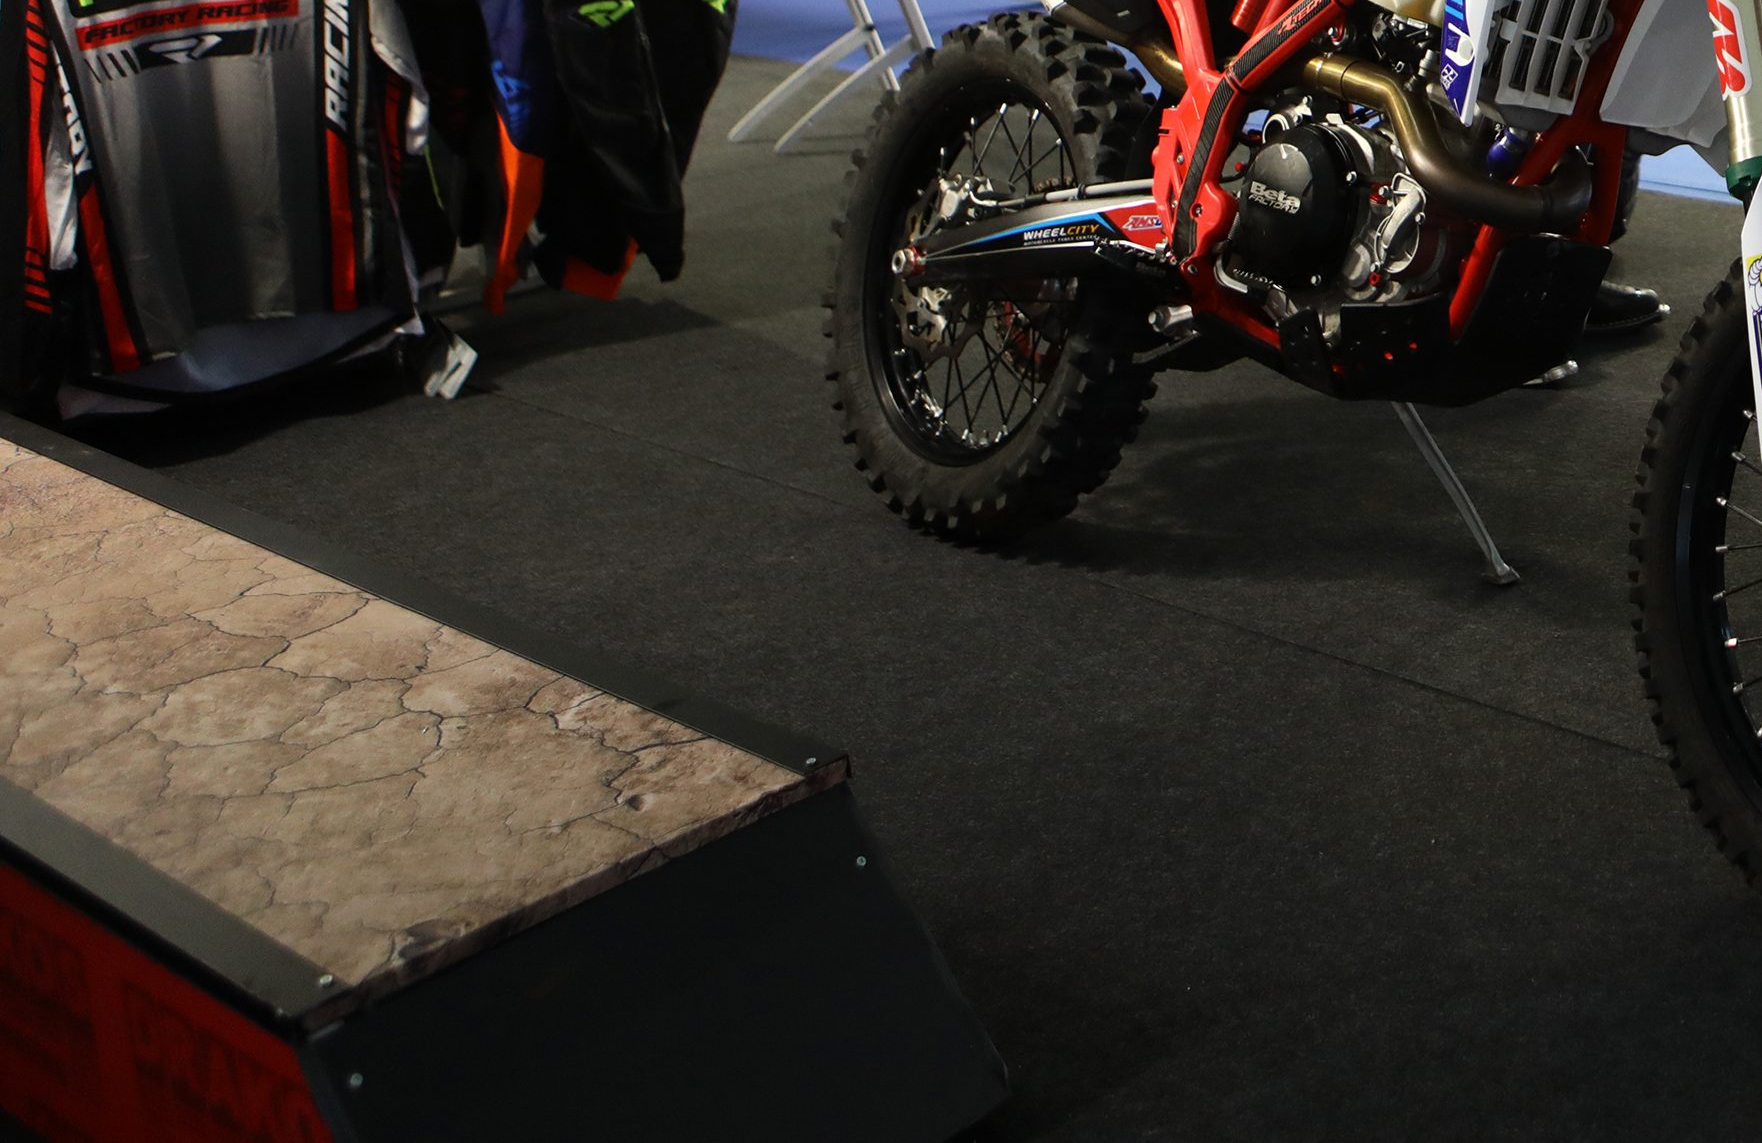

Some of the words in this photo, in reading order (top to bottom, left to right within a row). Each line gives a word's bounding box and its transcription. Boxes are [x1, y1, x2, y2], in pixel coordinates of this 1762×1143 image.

[84, 7, 190, 43] FACTORY
[196, 0, 290, 22] RACING
[1250, 180, 1301, 209] Beta
[1023, 224, 1100, 241] WHEELCITY
